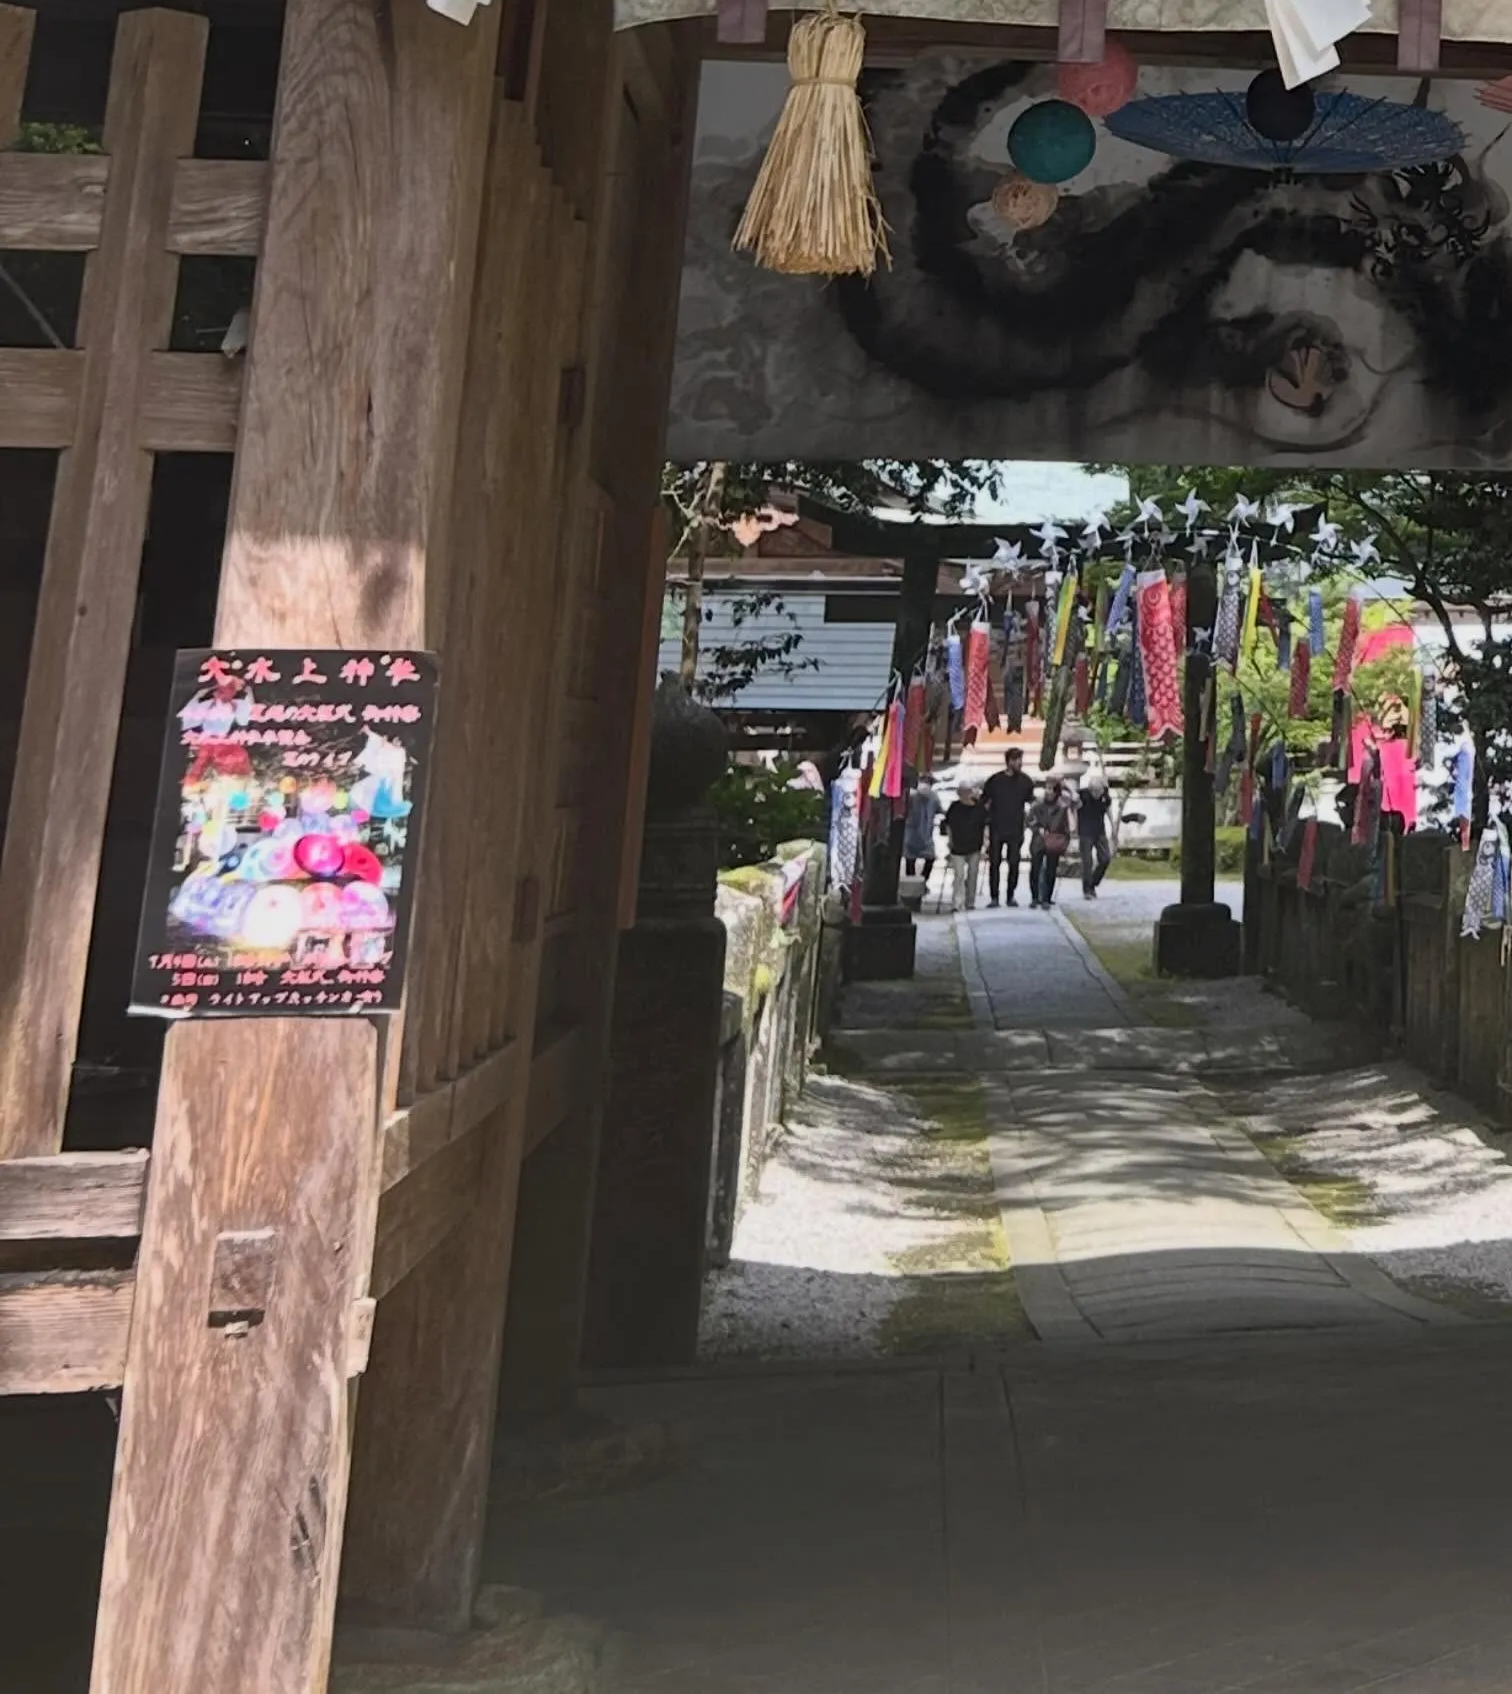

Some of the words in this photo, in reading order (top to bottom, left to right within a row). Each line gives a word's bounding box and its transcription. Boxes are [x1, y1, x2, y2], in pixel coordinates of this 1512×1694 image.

[198, 655, 421, 687] 大水上神社
